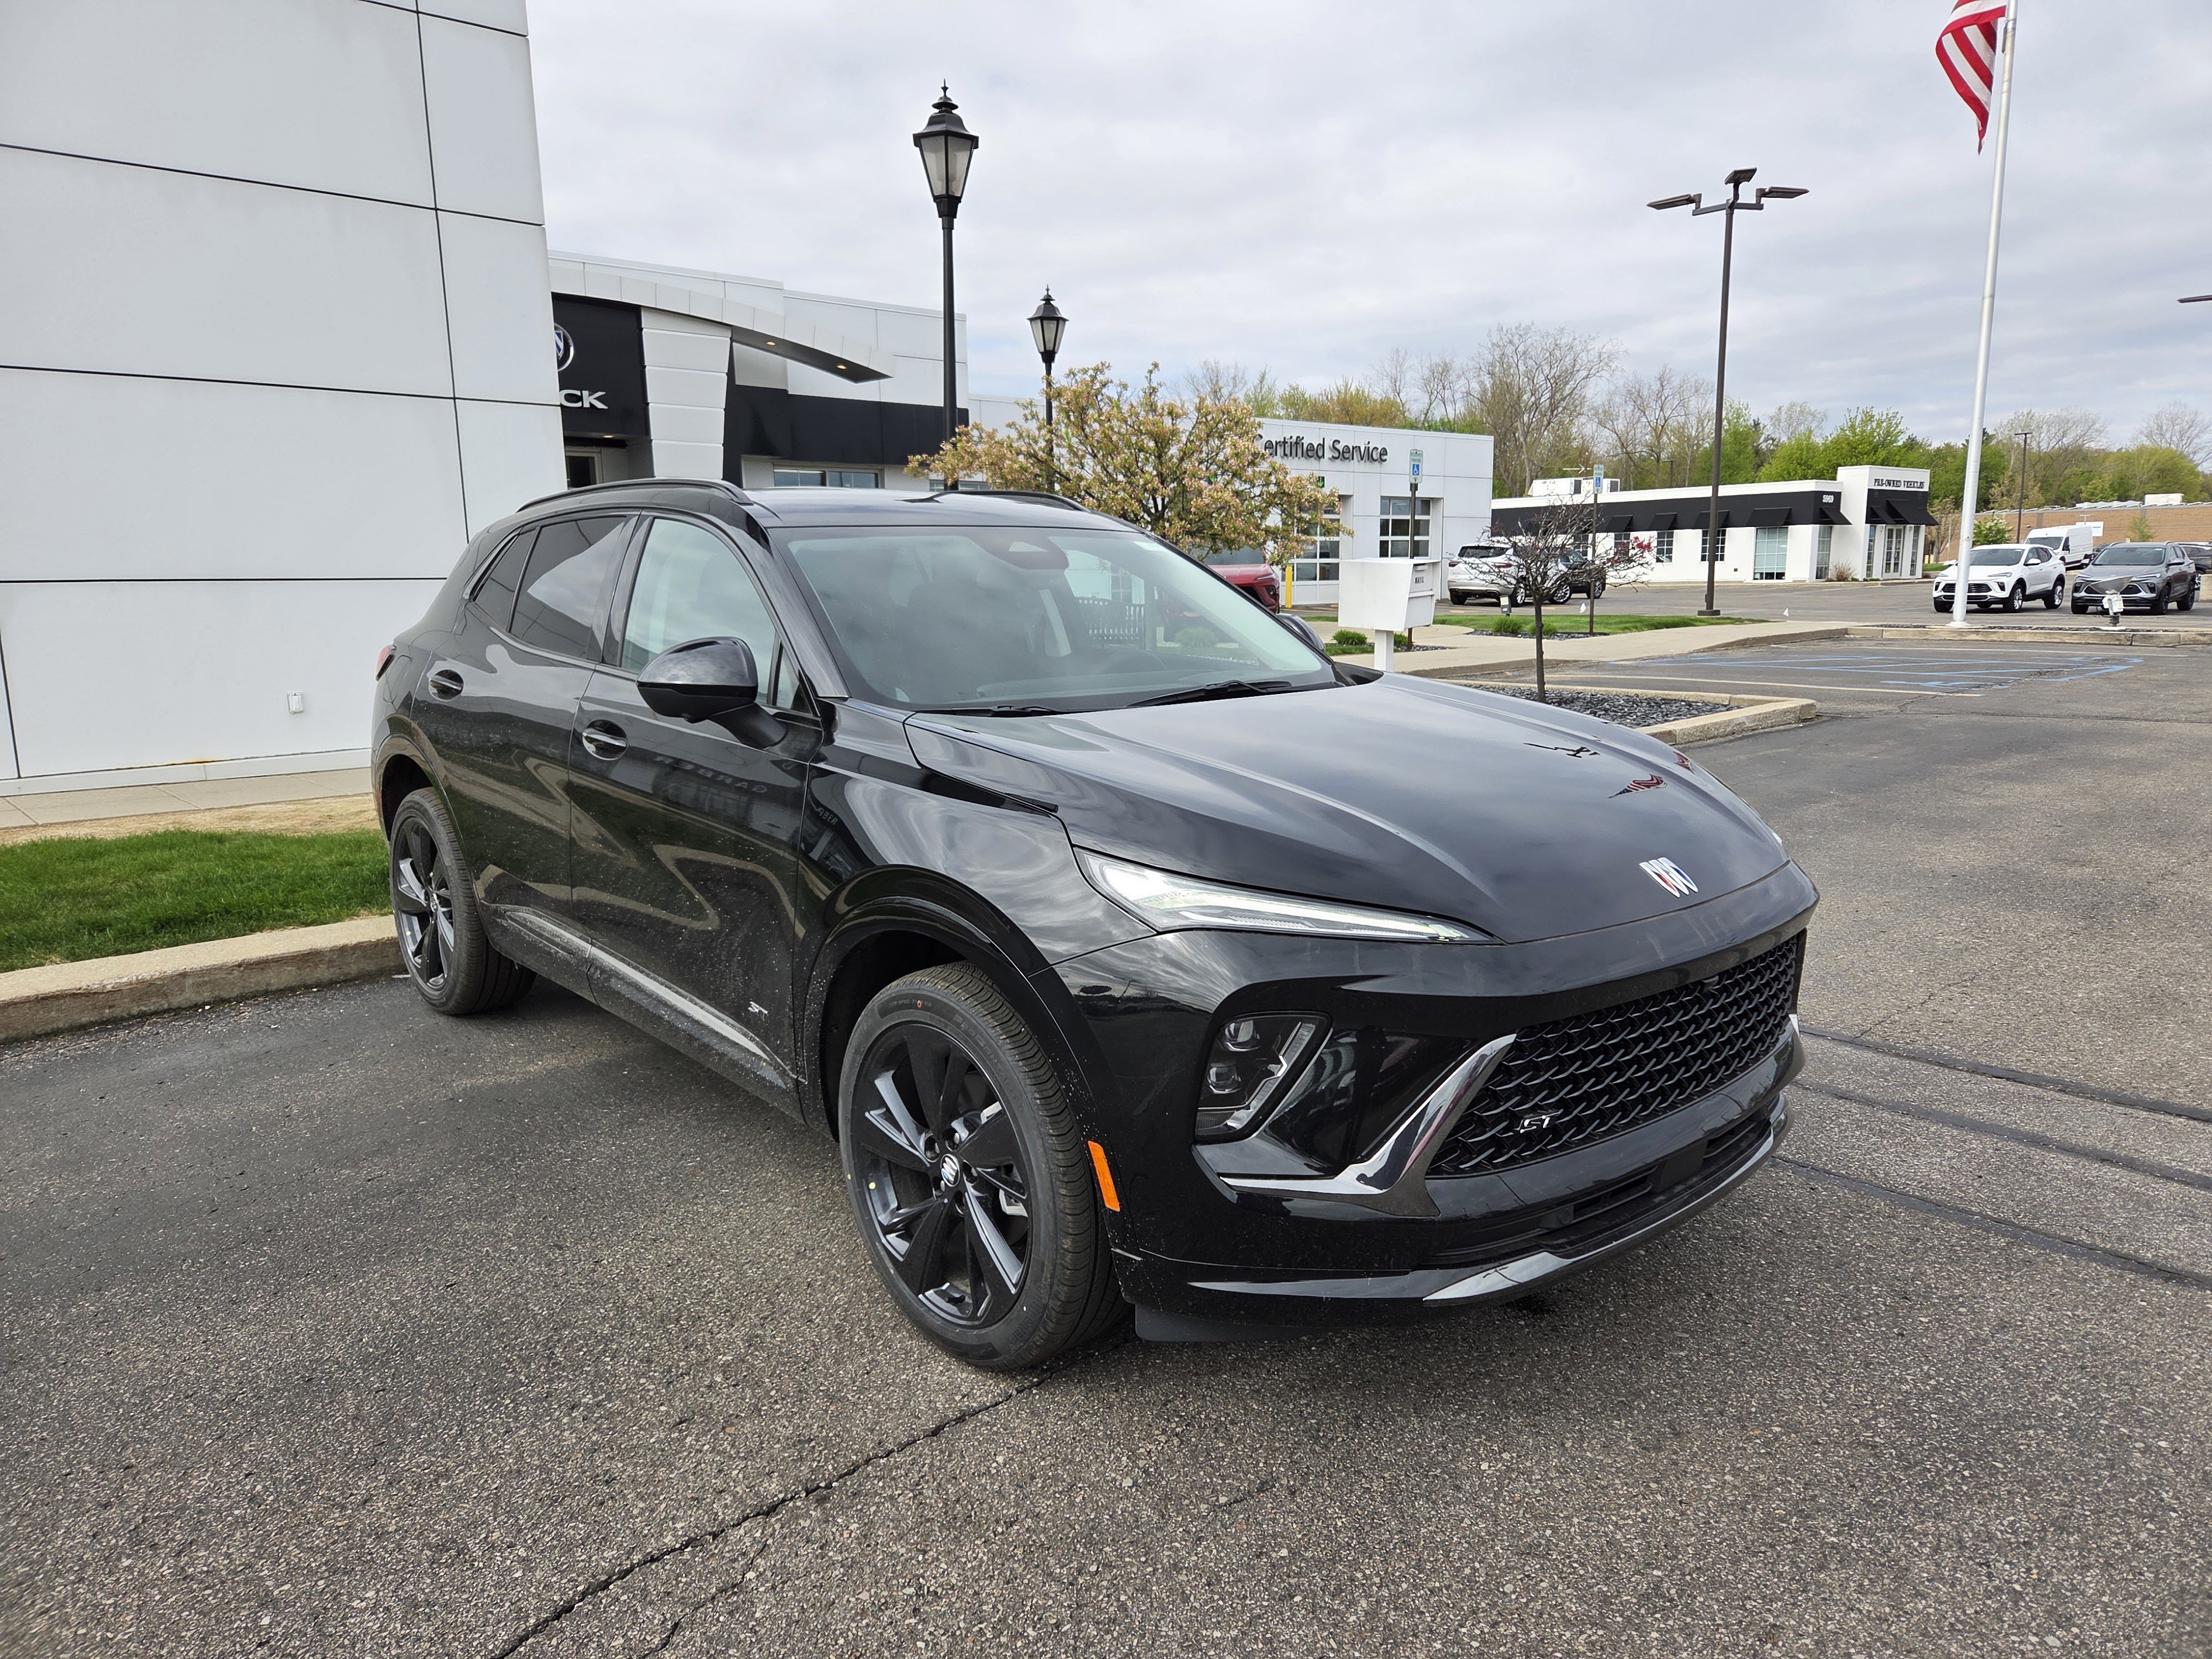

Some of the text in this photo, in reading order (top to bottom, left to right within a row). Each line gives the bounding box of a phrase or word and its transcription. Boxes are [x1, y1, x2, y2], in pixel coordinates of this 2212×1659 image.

[1256, 434, 1388, 463] ertified Service
[1874, 478, 1924, 489] PRE-OWNED VEHICLES
